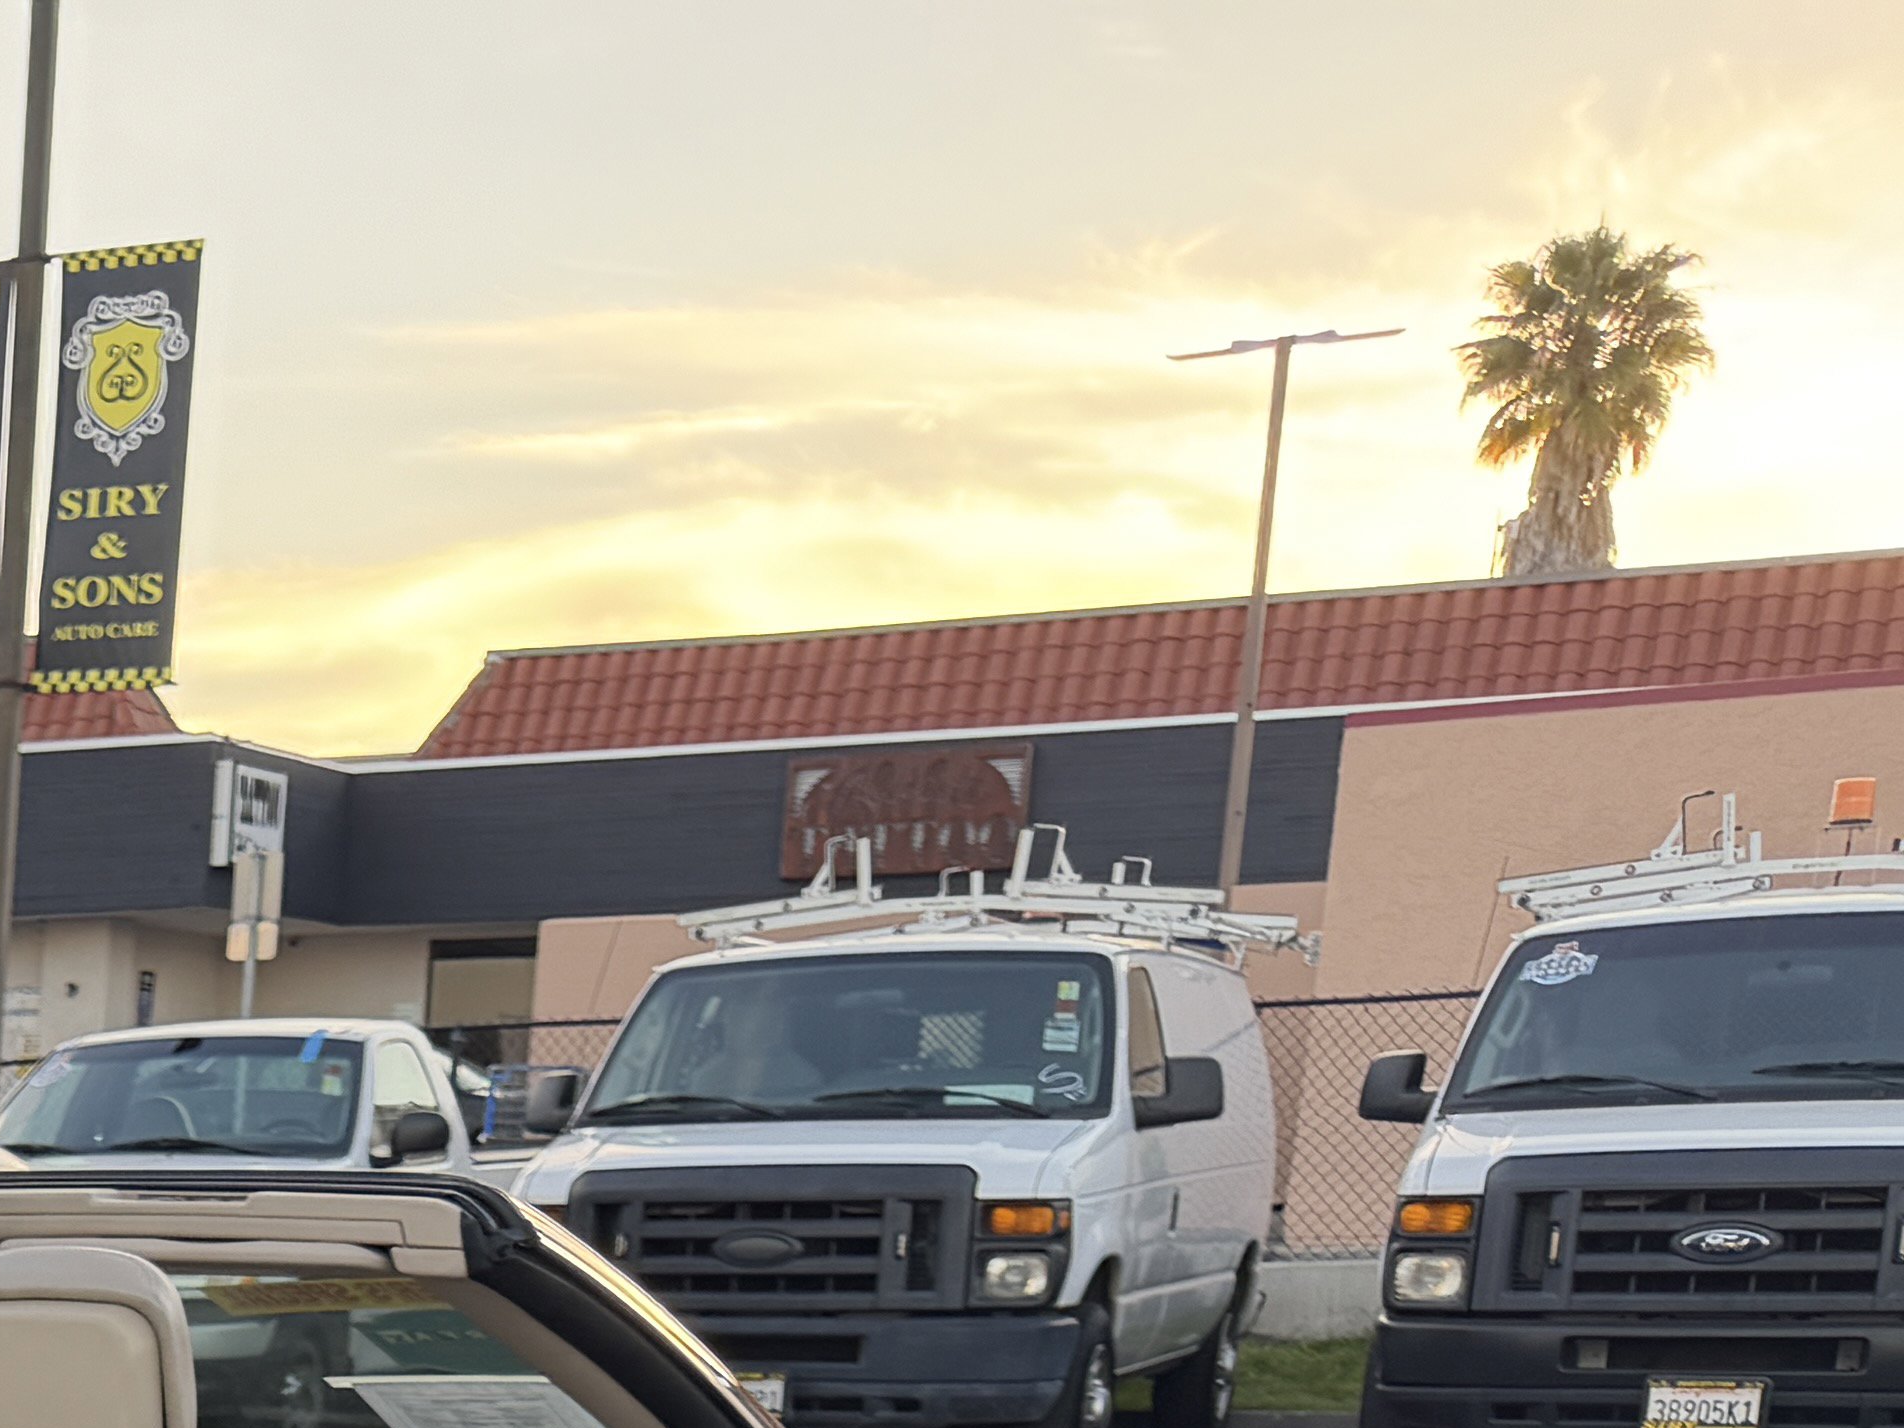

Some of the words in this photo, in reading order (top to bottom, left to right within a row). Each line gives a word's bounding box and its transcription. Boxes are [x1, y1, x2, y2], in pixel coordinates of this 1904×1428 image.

[57, 483, 169, 522] SIRY
[90, 532, 127, 559] &
[51, 573, 163, 609] SONS
